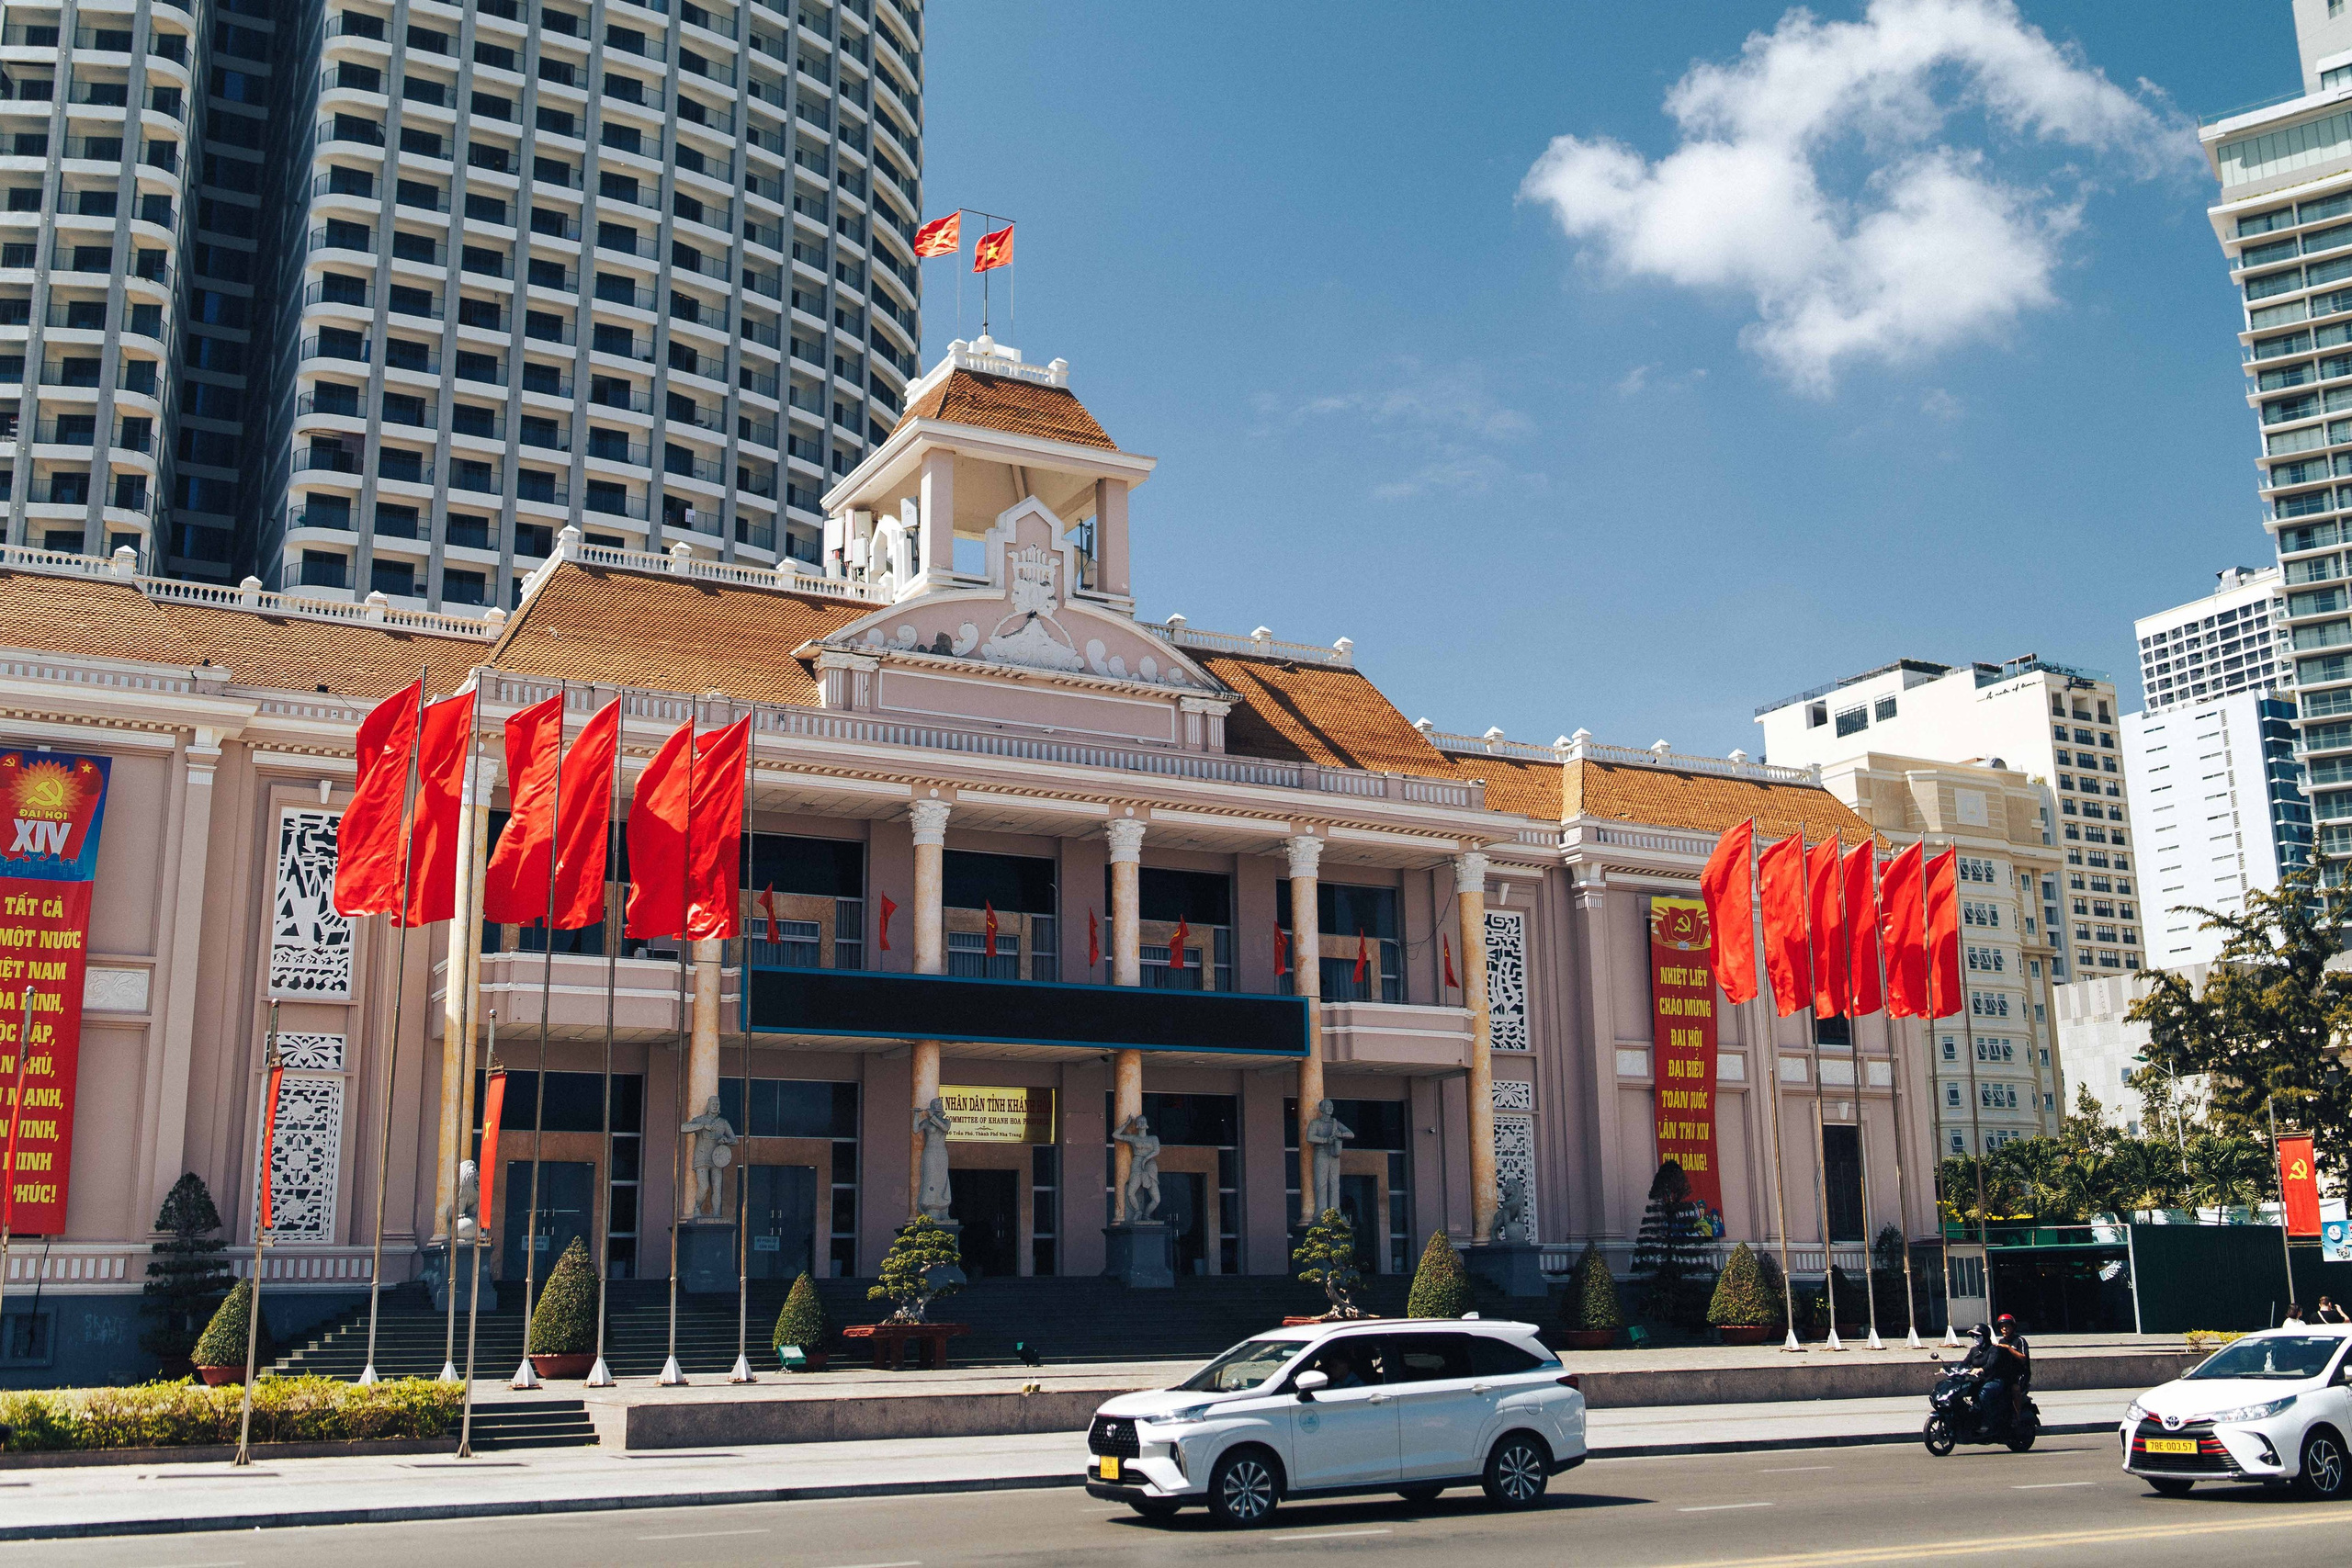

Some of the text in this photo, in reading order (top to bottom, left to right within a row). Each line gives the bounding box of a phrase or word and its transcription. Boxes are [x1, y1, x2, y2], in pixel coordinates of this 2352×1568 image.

[19, 808, 68, 821] ĐẠI HỘI
[9, 818, 73, 854] XIV
[5, 891, 63, 919] TẤT CẢ
[0, 925, 82, 951] MỘT NƯỚC
[28, 961, 67, 980] NAM
[1660, 964, 1708, 990] NHIỆT LIỆT
[1659, 995, 1712, 1018] CHÀO MỪNG
[1670, 1026, 1702, 1051] ĐẠI HỘI
[1668, 1054, 1704, 1080] ĐẠI BIỂU
[945, 1094, 967, 1111] NHÂN
[969, 1094, 985, 1111] DÂN
[987, 1093, 1005, 1112] TỈNH
[1007, 1096, 1035, 1113] KHÁNH
[1661, 1086, 1708, 1111] TOÀN QUỐC
[1658, 1114, 1709, 1140] LẦN THỨ XIV
